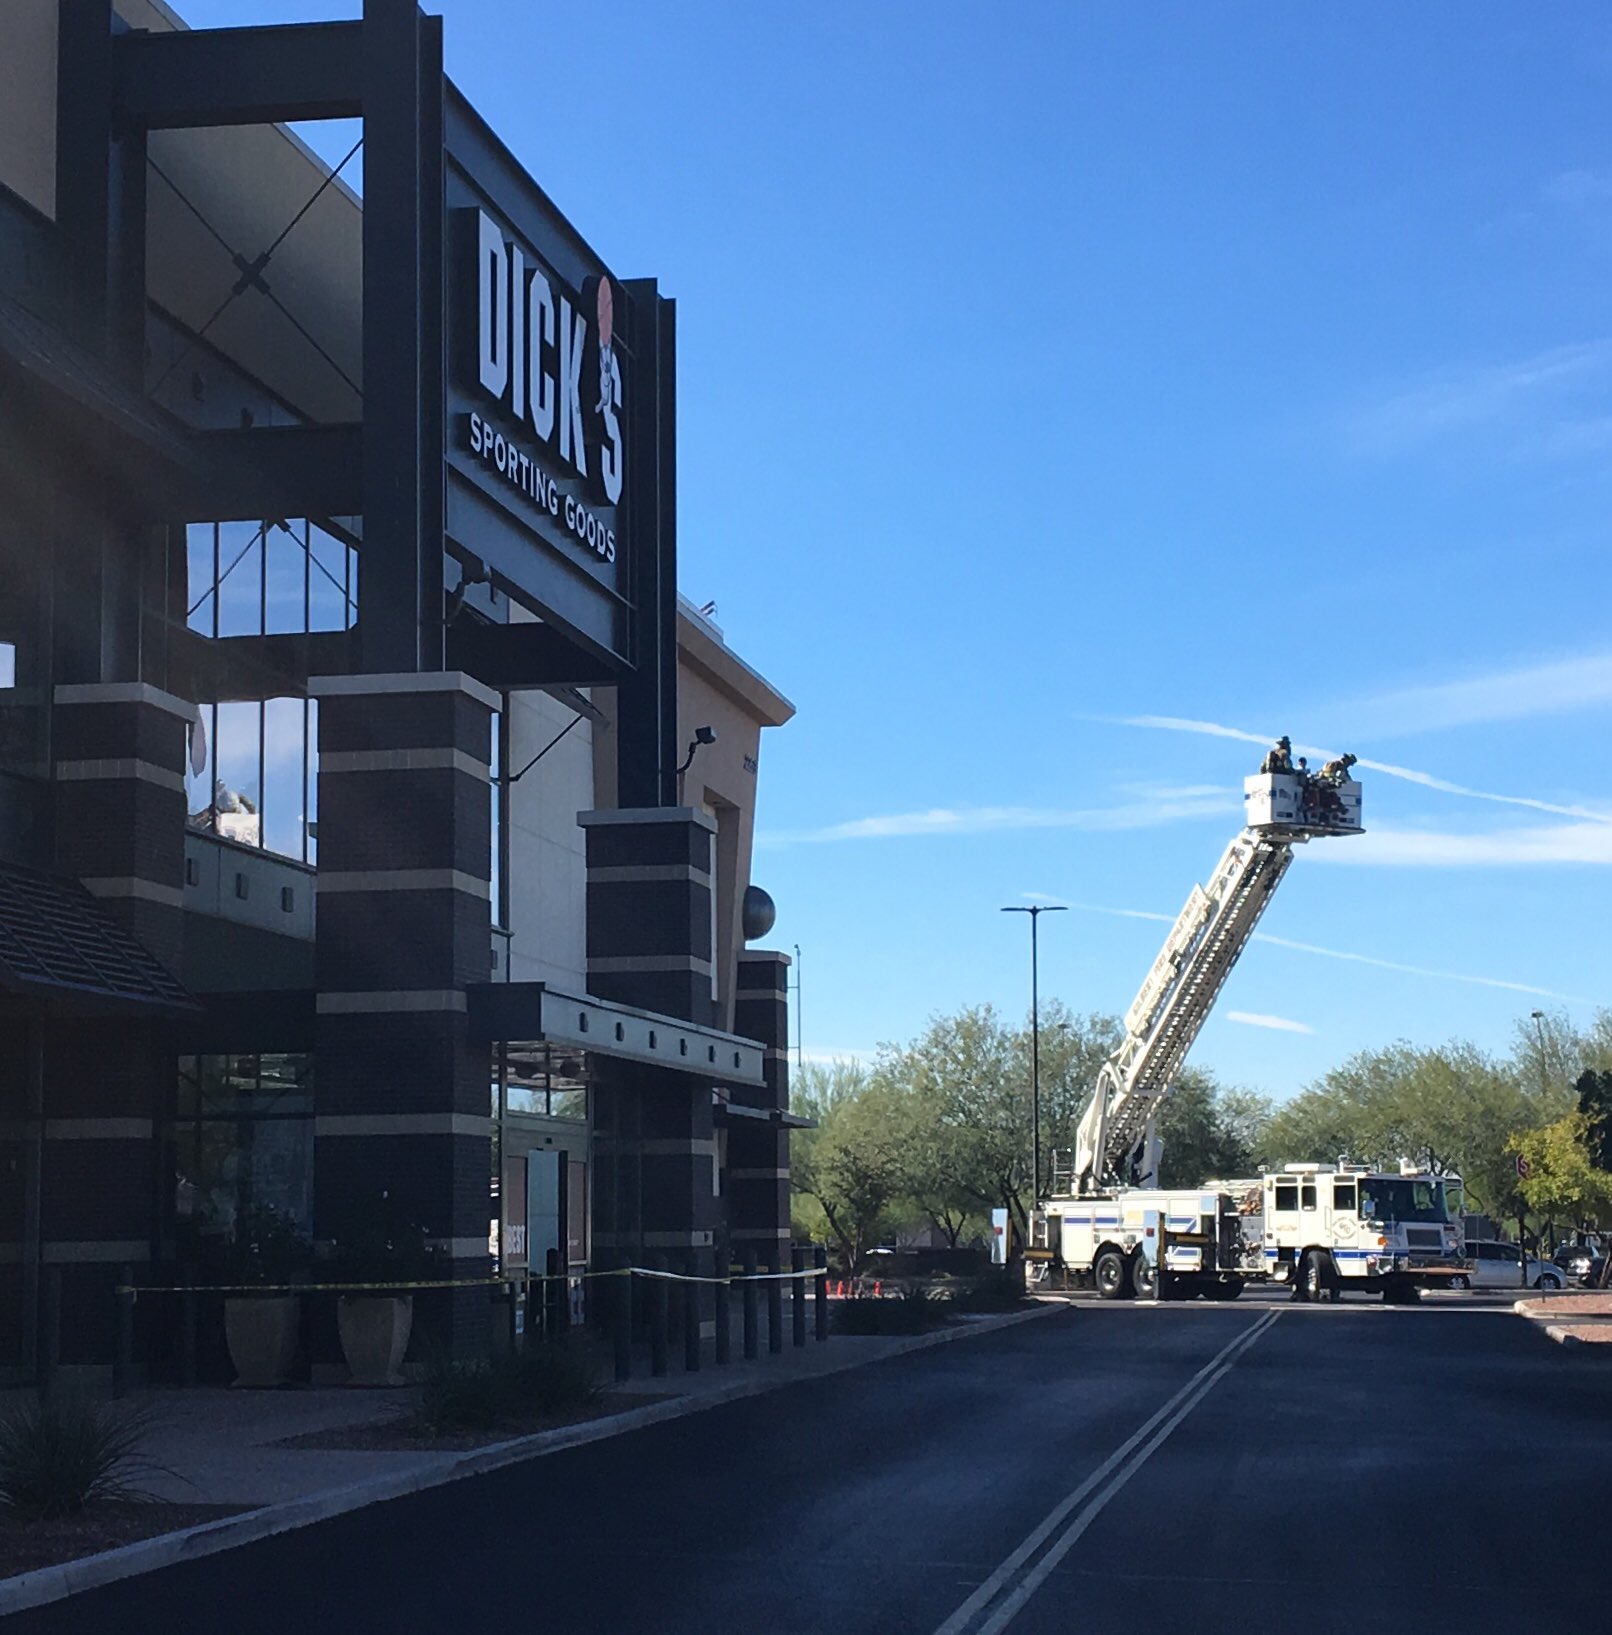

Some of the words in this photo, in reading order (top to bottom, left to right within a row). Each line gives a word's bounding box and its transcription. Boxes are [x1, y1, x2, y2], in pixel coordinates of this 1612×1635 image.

[478, 209, 623, 506] DICK'S
[469, 411, 559, 516] SPORTING
[565, 494, 616, 564] GOODS
